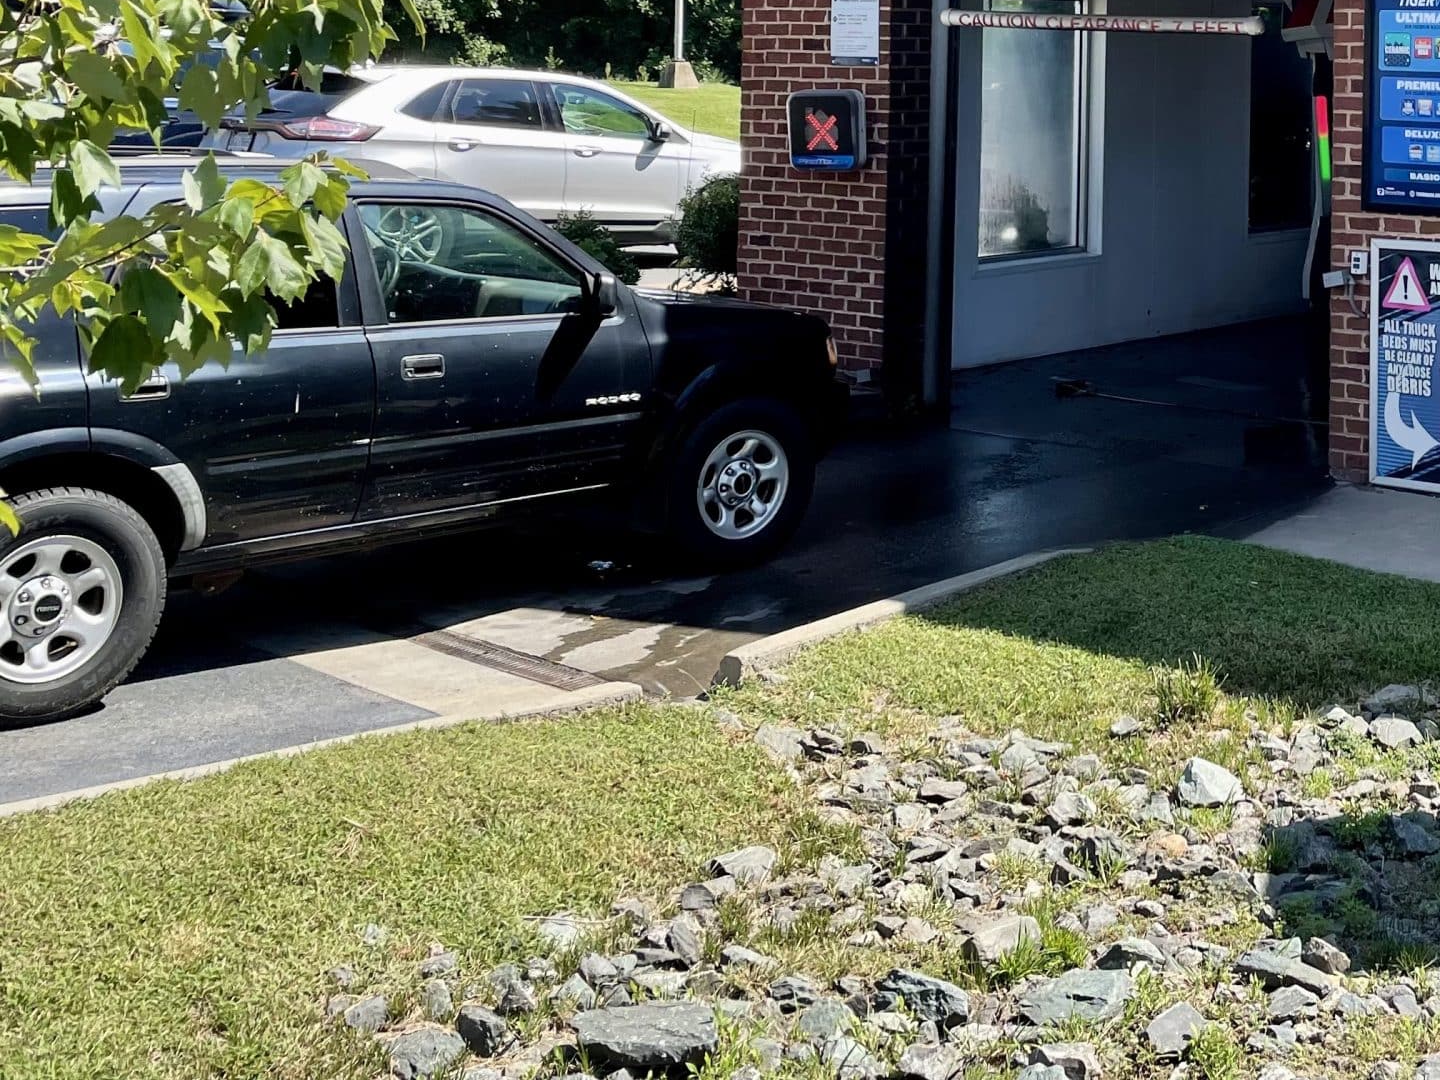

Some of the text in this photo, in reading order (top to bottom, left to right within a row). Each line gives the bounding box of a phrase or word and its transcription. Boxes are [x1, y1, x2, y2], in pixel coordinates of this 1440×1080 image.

[959, 13, 1244, 33] CAUTION CLEARANCE 7 FEET
[1409, 172, 1440, 182] BASIC
[1383, 319, 1436, 338] ALL TRUCK
[1382, 335, 1438, 354] BEDS MUST
[1384, 350, 1435, 367] BE CLEAR OF
[1387, 376, 1432, 397] DEBRIS
